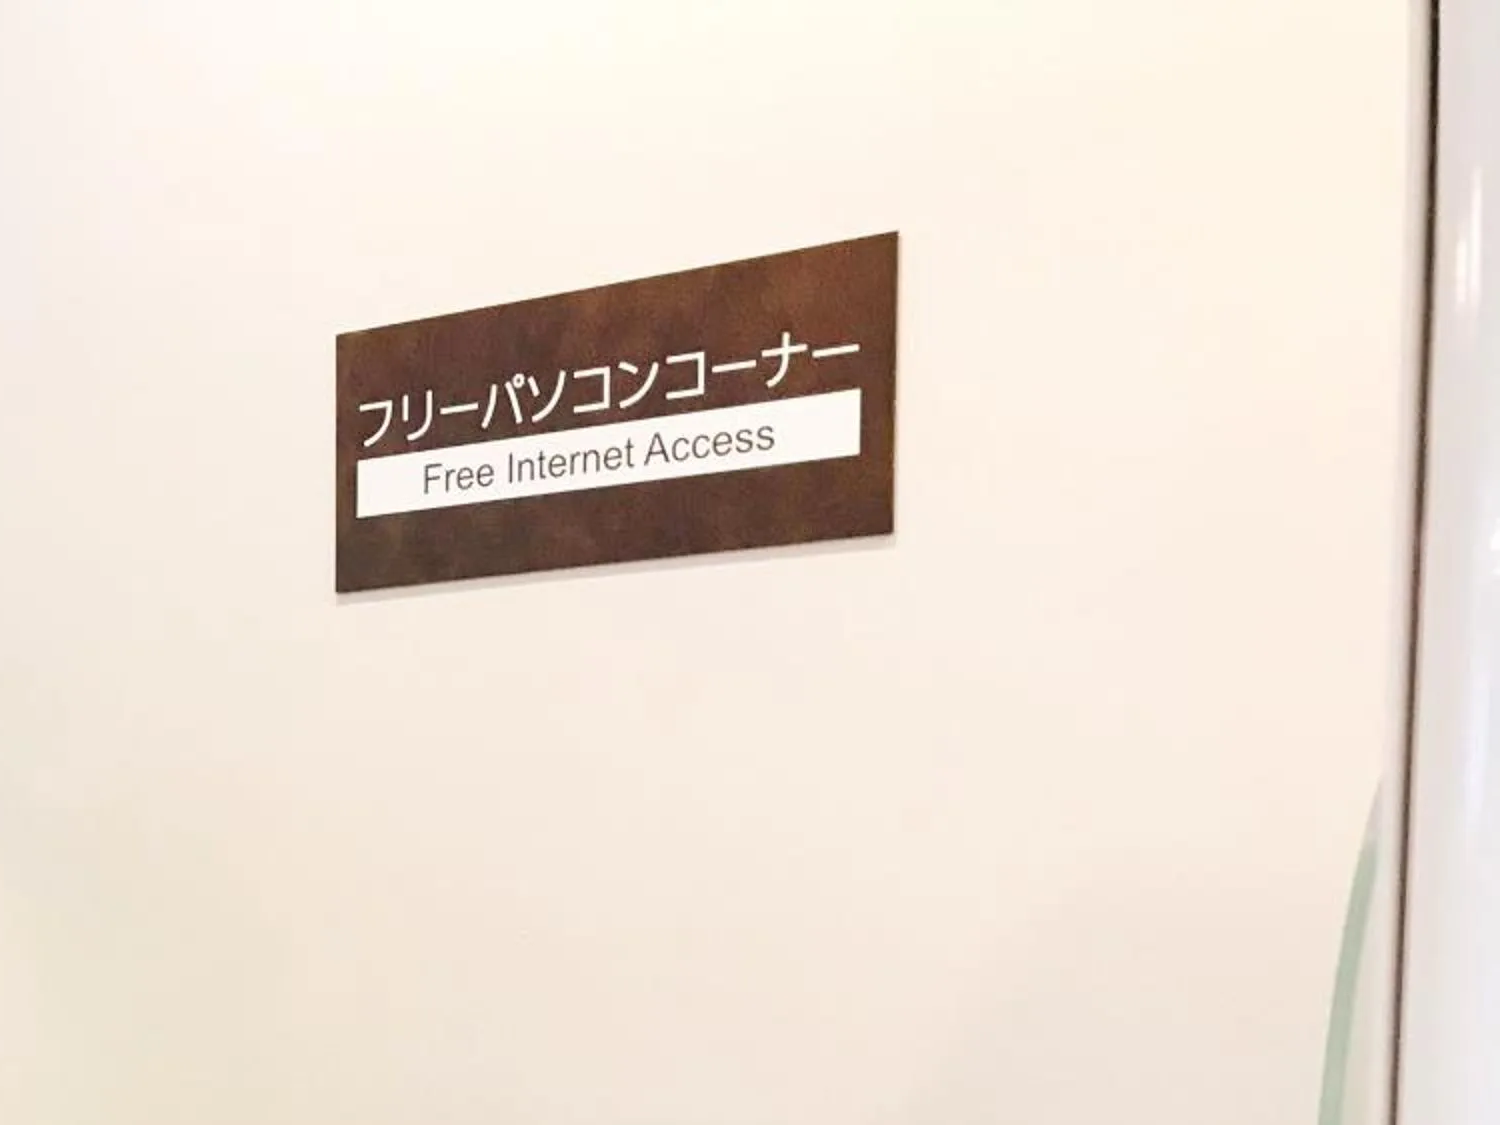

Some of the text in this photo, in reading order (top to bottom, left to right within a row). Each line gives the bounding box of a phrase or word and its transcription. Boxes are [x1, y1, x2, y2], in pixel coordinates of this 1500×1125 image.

[358, 331, 860, 448] フリーパソコンコーナー
[423, 425, 775, 494] Free Internet Access
